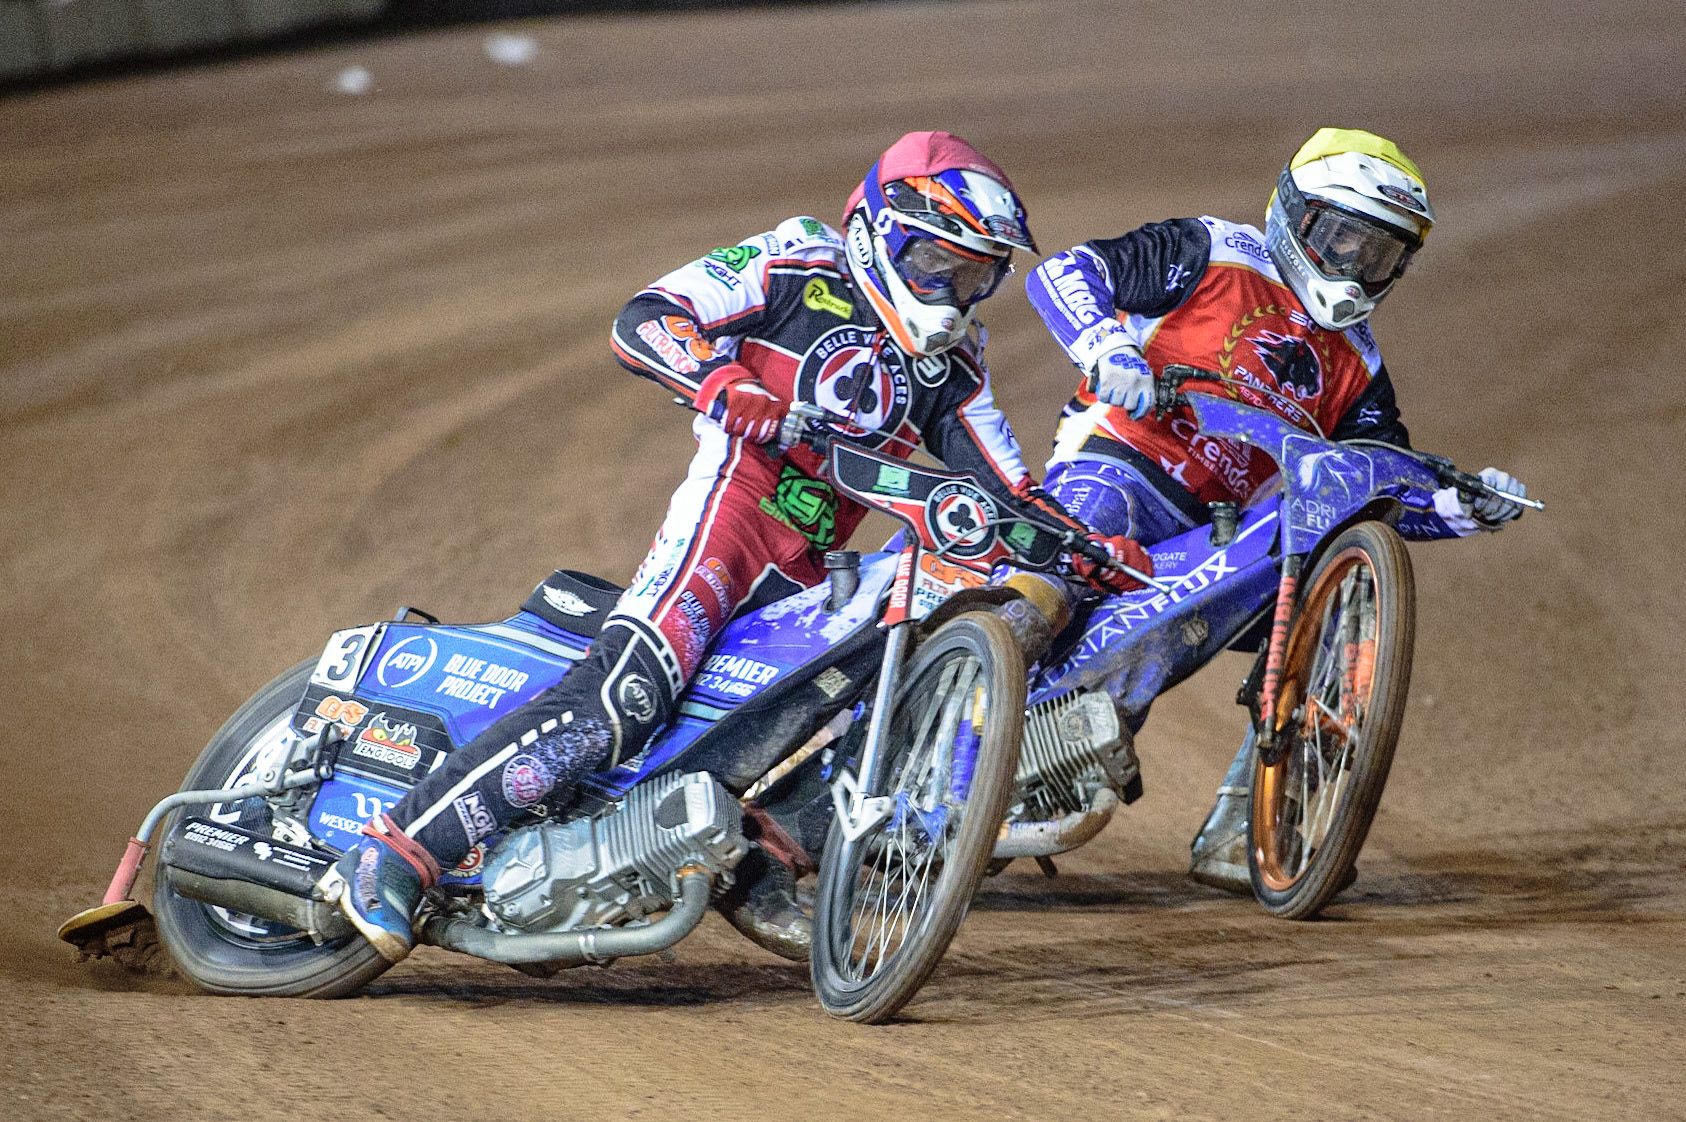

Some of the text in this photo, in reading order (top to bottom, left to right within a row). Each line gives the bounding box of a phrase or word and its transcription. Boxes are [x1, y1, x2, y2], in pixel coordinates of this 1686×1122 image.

[1224, 236, 1272, 260] Crendo
[815, 331, 858, 361] BELLE
[888, 364, 908, 405] ACES
[1291, 497, 1337, 521] ADRI
[327, 634, 366, 681] 3
[388, 652, 427, 672] ATPI
[443, 653, 529, 693] BLUE DOOR
[435, 675, 506, 709] PROJECT
[185, 821, 250, 845] PREMIER
